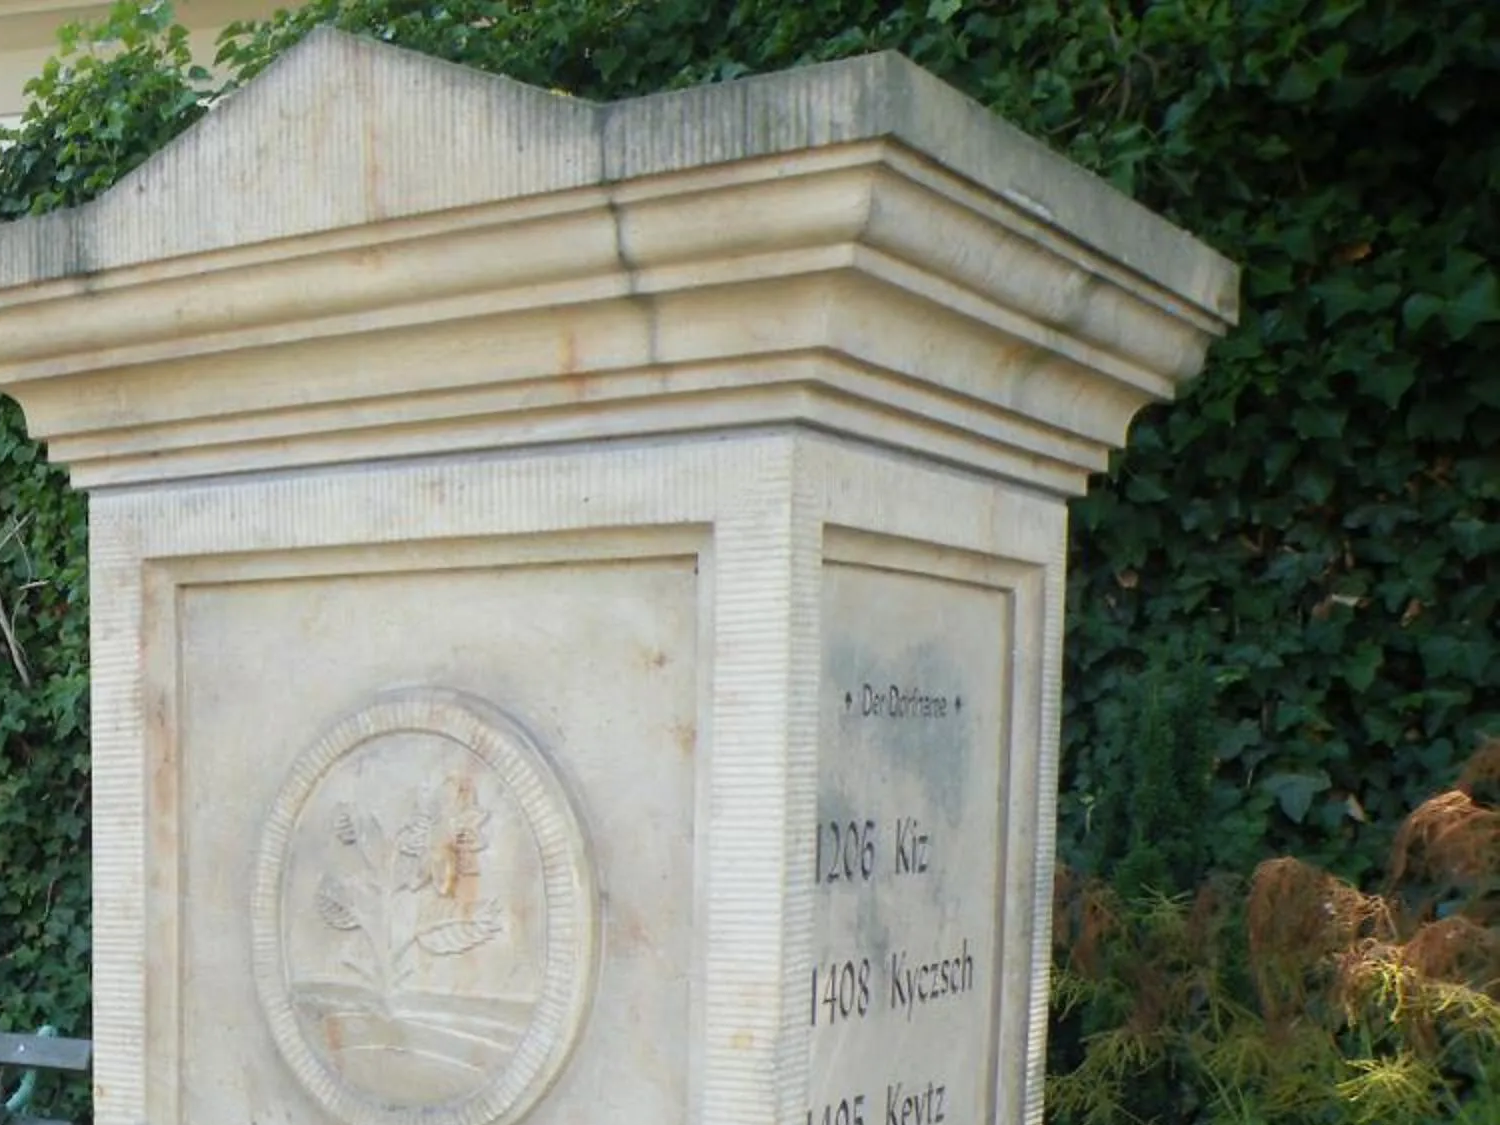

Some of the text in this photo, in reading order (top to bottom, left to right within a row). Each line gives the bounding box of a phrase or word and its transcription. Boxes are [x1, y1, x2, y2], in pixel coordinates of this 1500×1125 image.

[814, 815, 930, 884] 1206 Kiz
[810, 938, 974, 1027] 1408 Kyczsch
